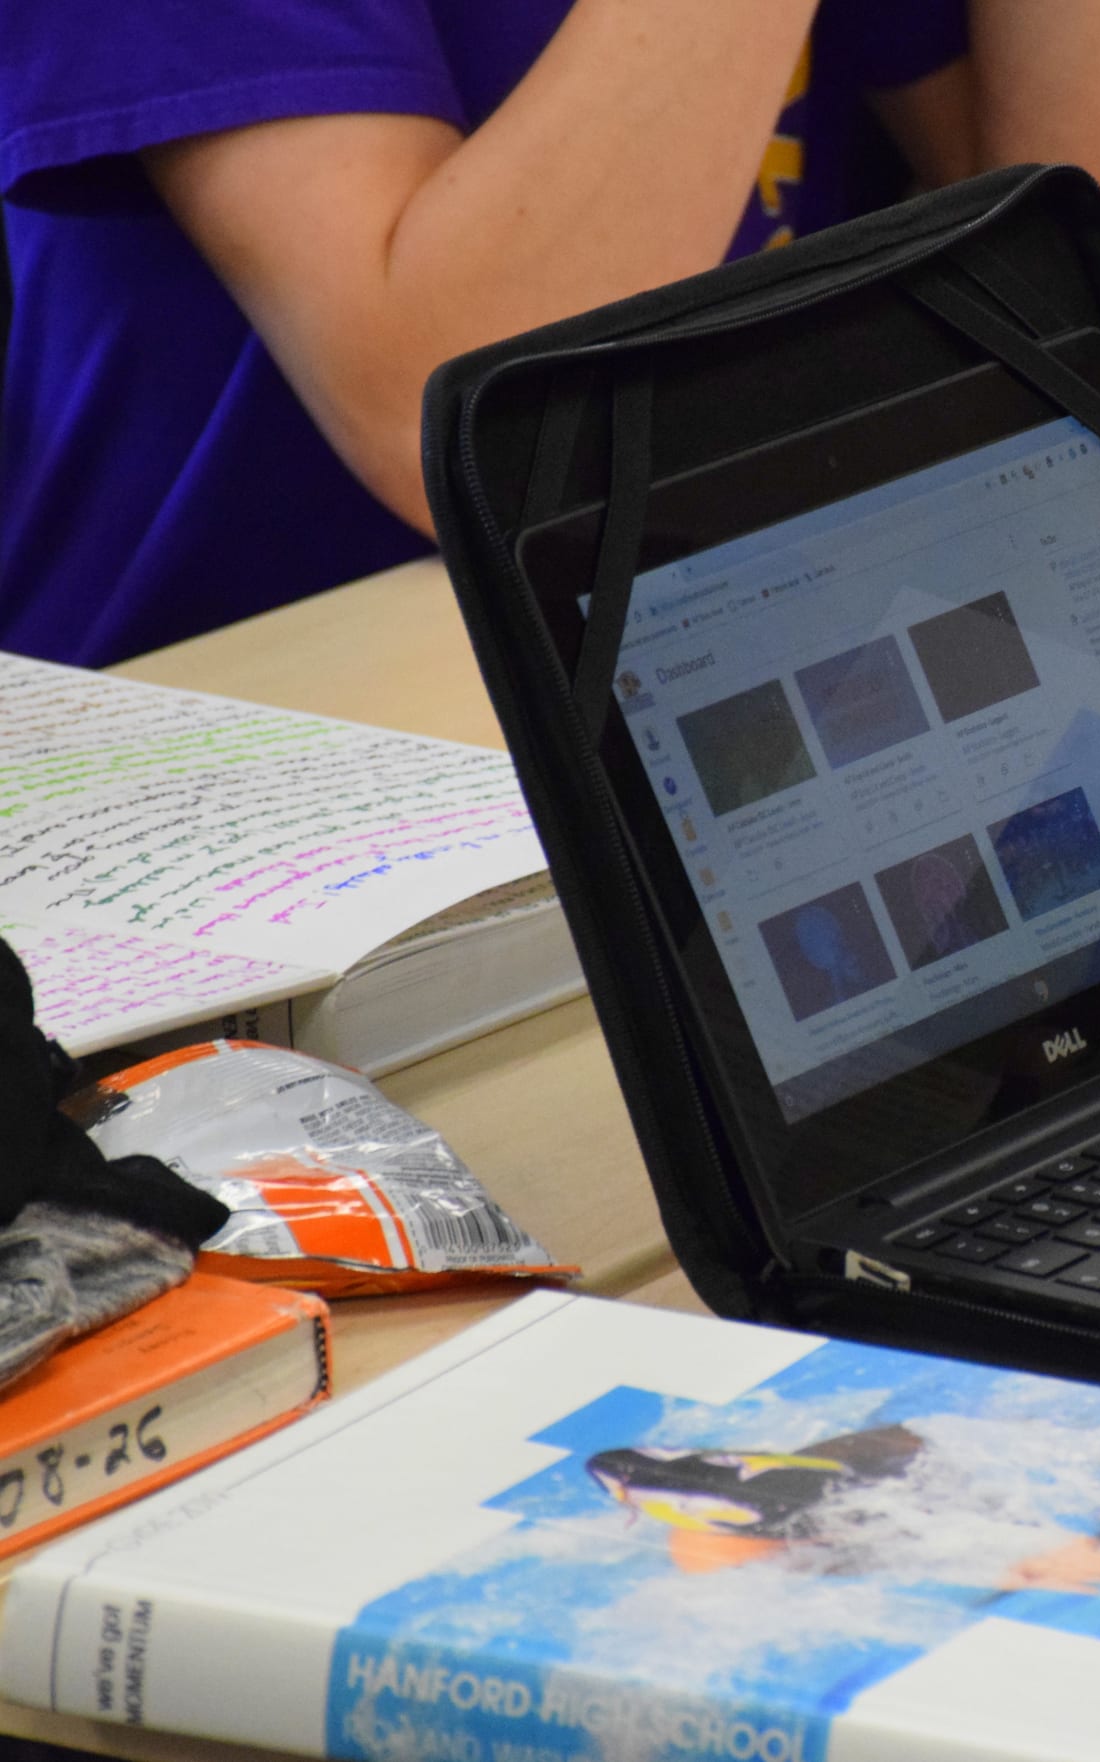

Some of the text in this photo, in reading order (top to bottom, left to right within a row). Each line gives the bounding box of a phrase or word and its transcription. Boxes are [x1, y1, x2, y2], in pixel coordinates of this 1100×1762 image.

[655, 652, 717, 686] Dashboard
[1042, 1028, 1088, 1064] DELL
[125, 1598, 153, 1725] MOMENTUM
[347, 1652, 531, 1719] HANFORD
